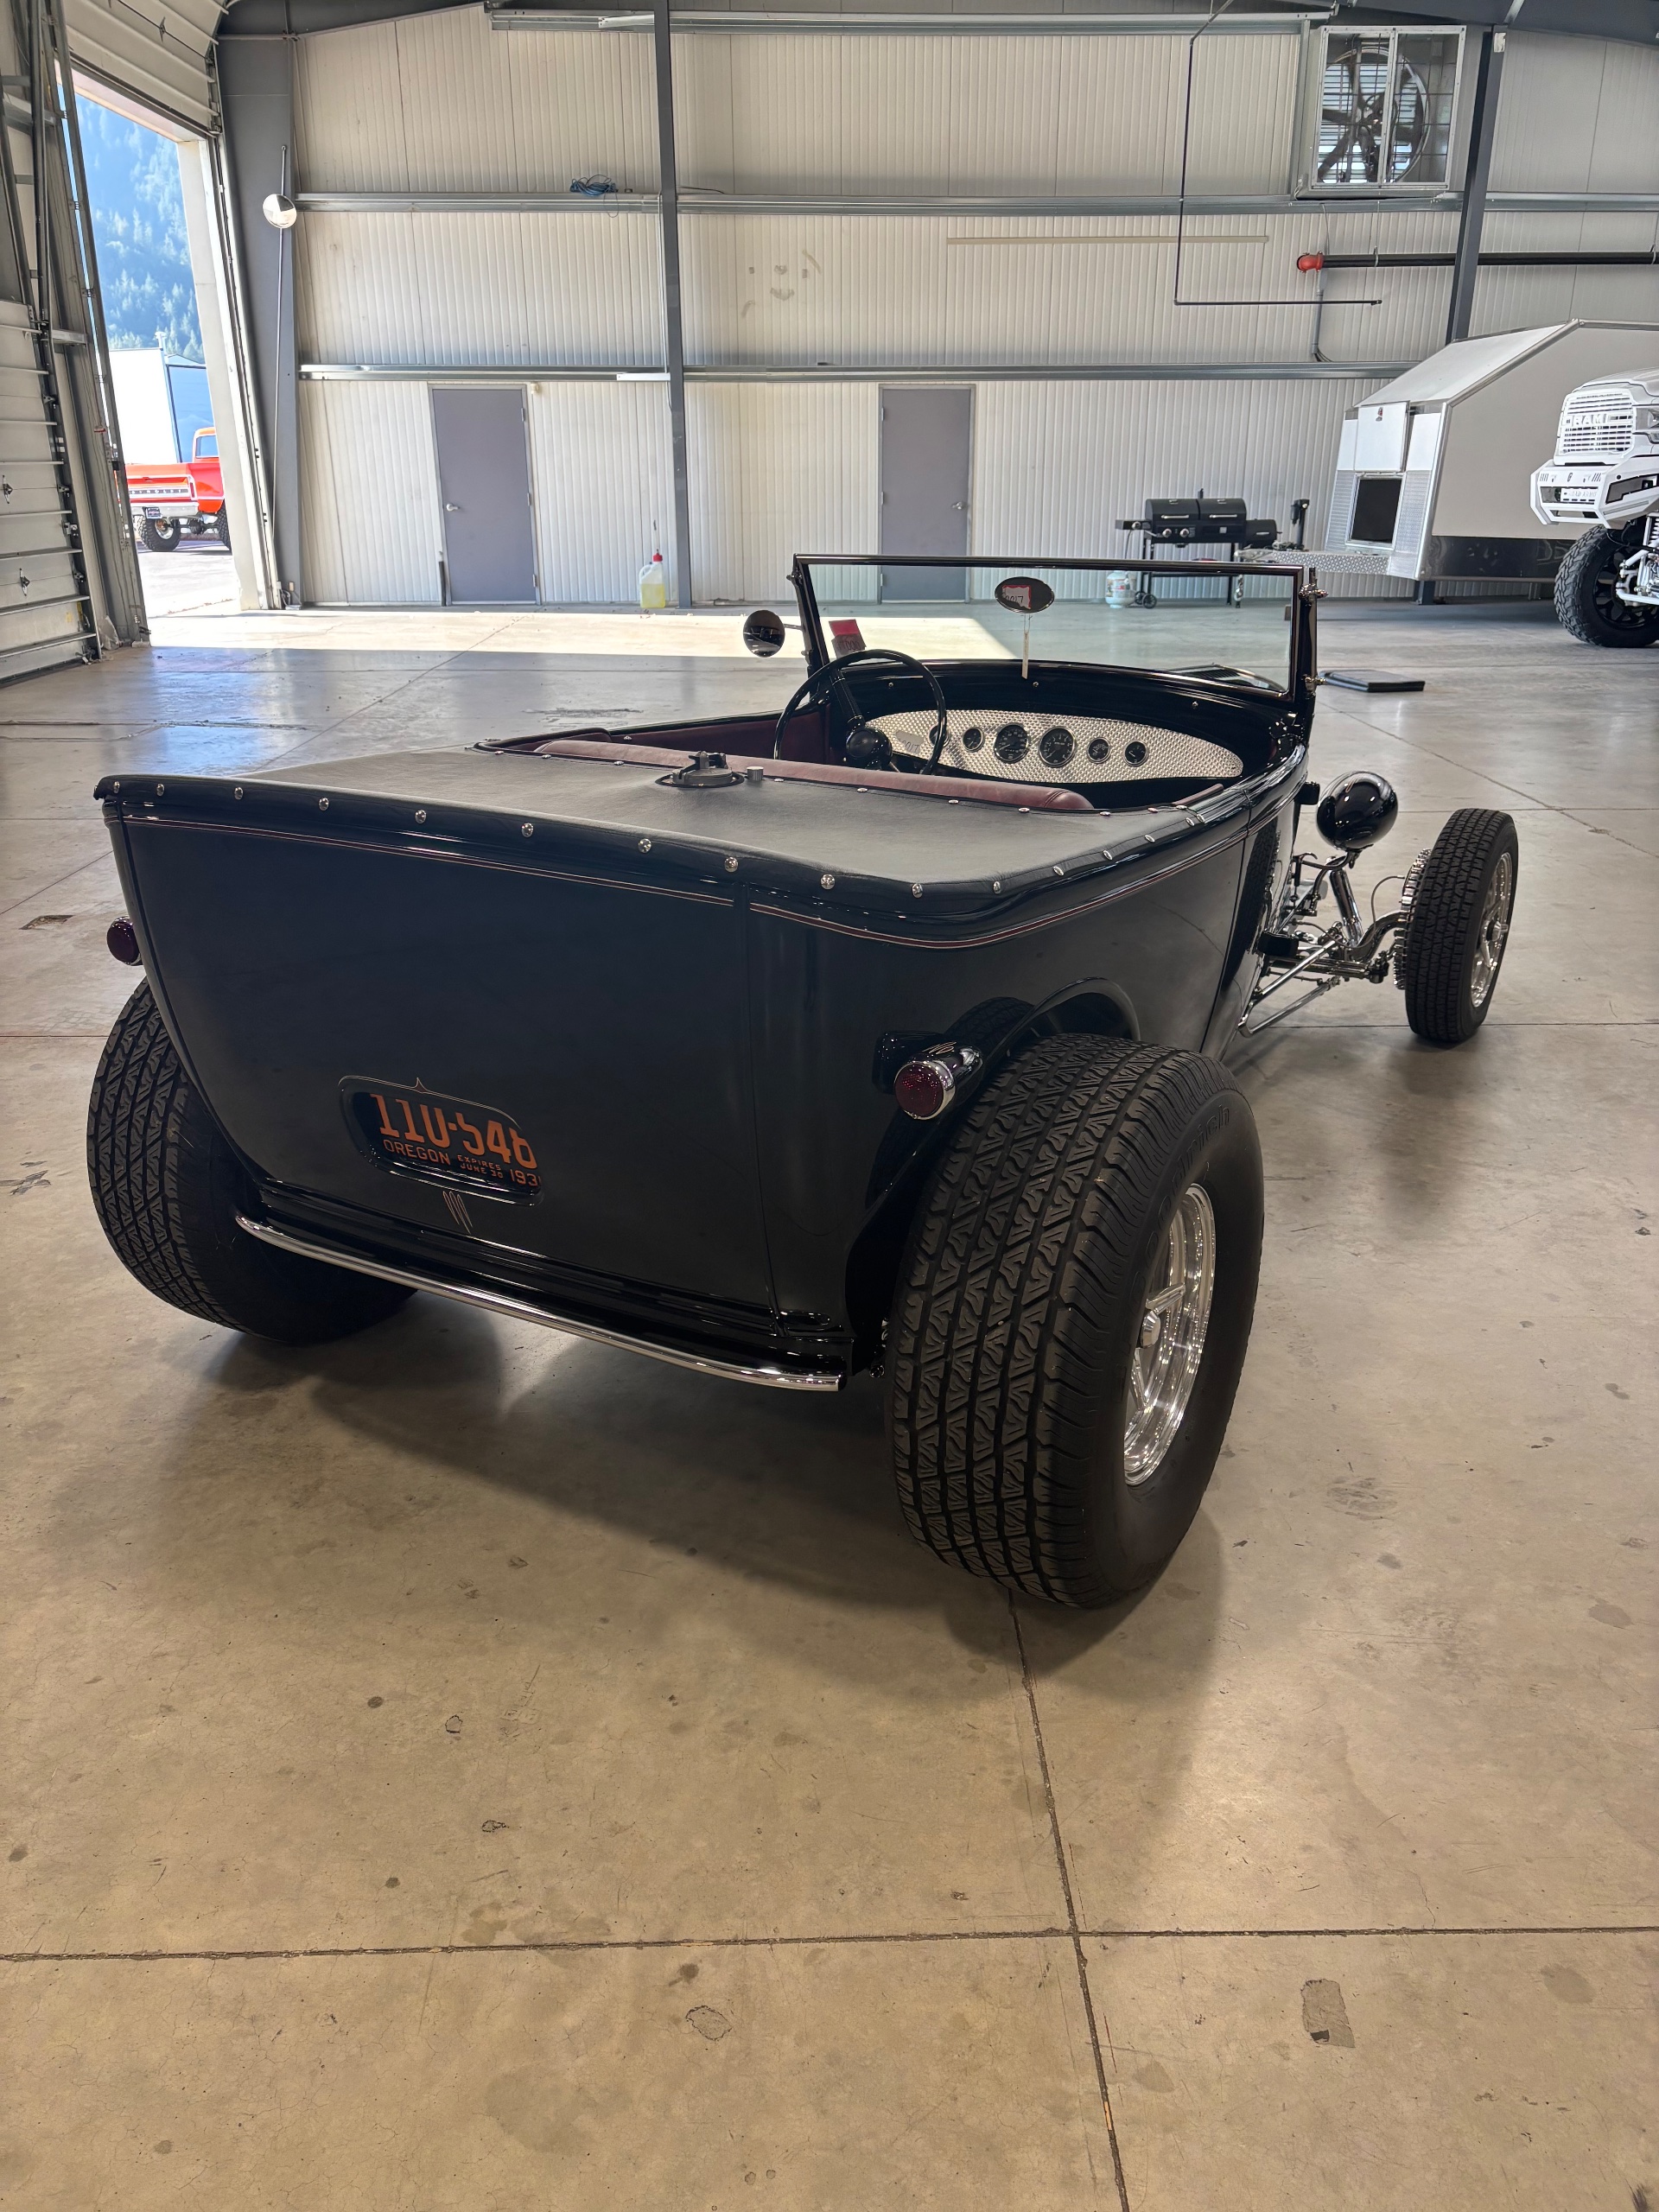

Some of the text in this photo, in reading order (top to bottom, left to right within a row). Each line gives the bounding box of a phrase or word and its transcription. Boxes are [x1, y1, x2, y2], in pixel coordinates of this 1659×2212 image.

[1572, 414, 1607, 426] RAM
[383, 1139, 451, 1166] OREGON
[457, 1154, 501, 1171] EXPIRES
[461, 1162, 504, 1179] JUNE 30
